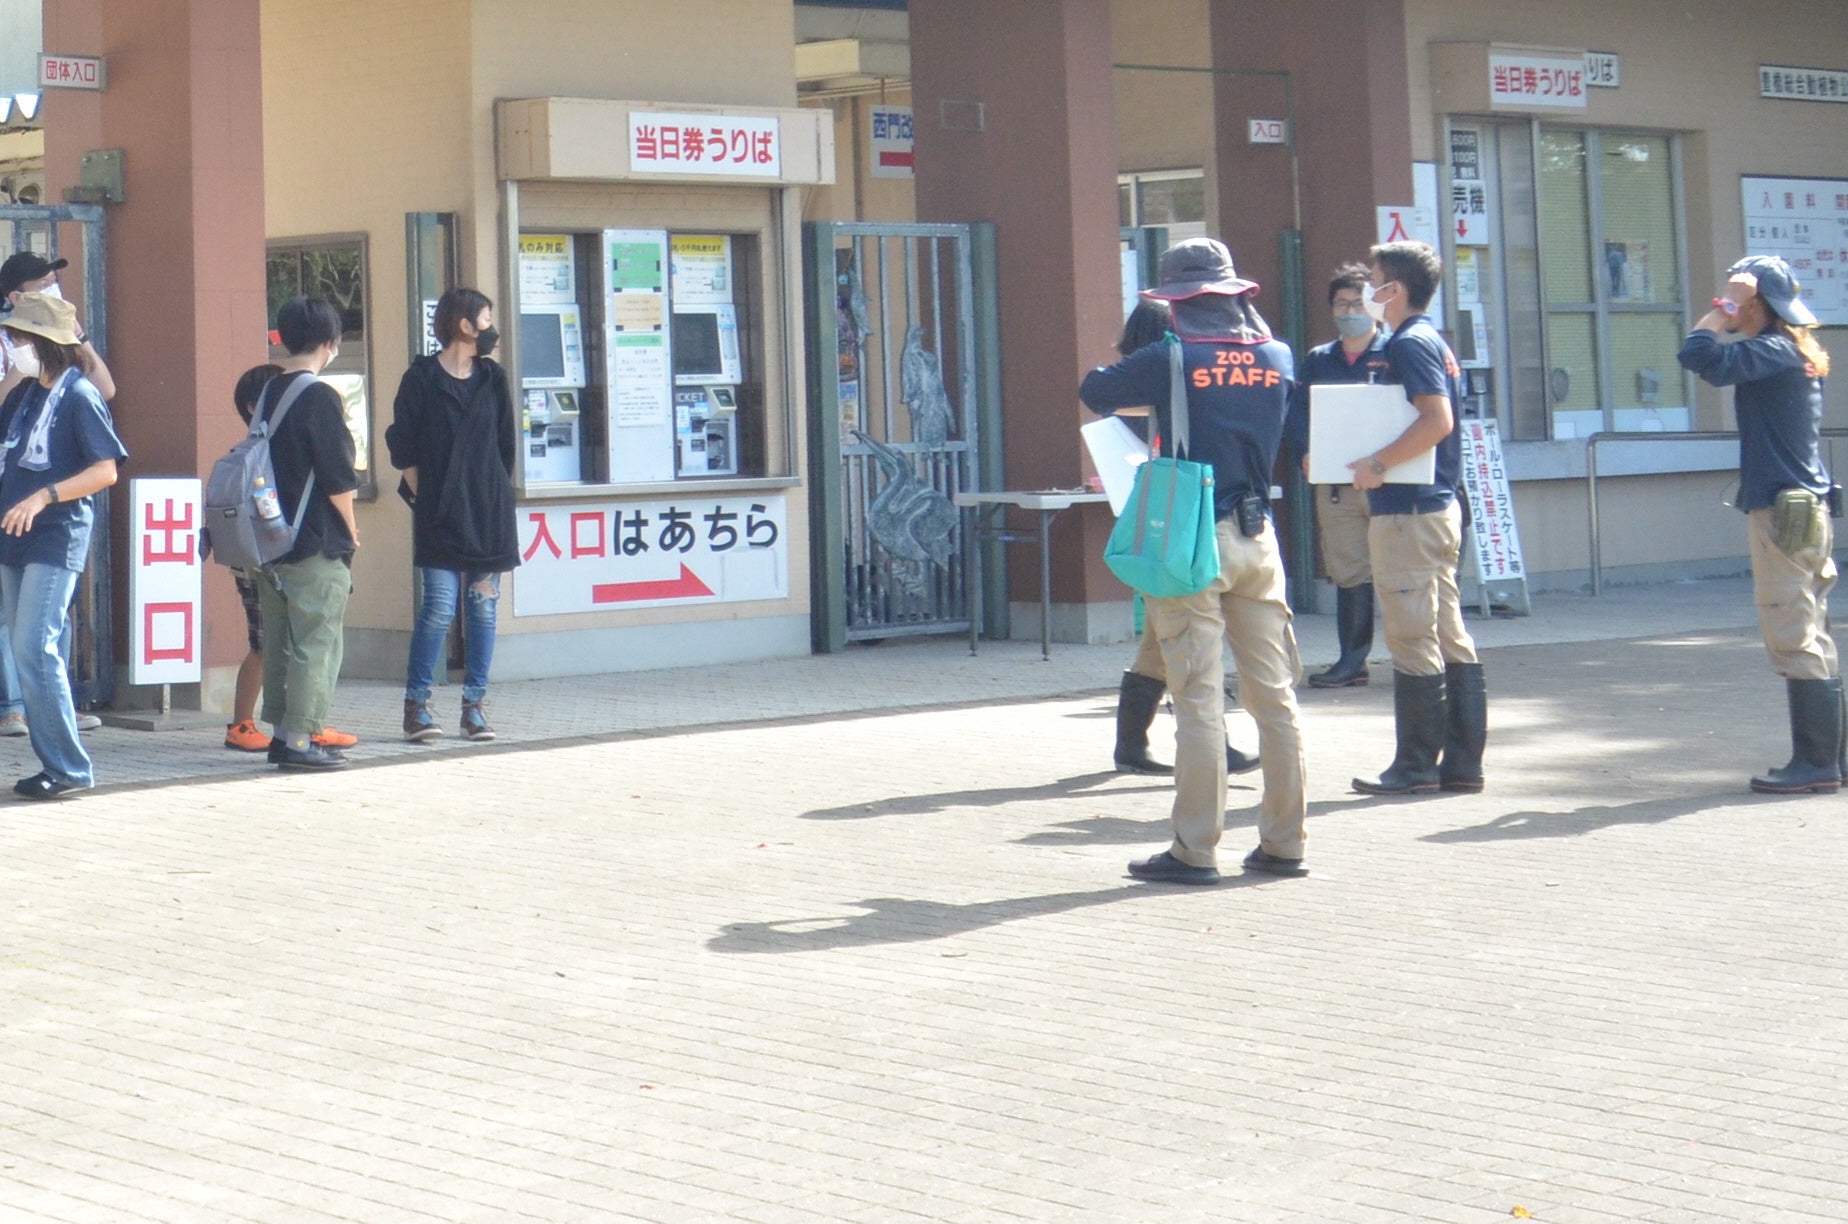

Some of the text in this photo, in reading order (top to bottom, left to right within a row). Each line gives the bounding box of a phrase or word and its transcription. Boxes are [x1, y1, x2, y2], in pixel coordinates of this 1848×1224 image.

[46, 60, 96, 82] 団体入口
[1494, 65, 1582, 96] 当日券うりば
[1255, 122, 1283, 139] 入口
[635, 124, 774, 165] 当日券うりば
[1216, 351, 1255, 366] ZOO
[1193, 367, 1281, 388] STAFF
[522, 503, 779, 560] 入口はあちら
[143, 498, 195, 665] 出口
